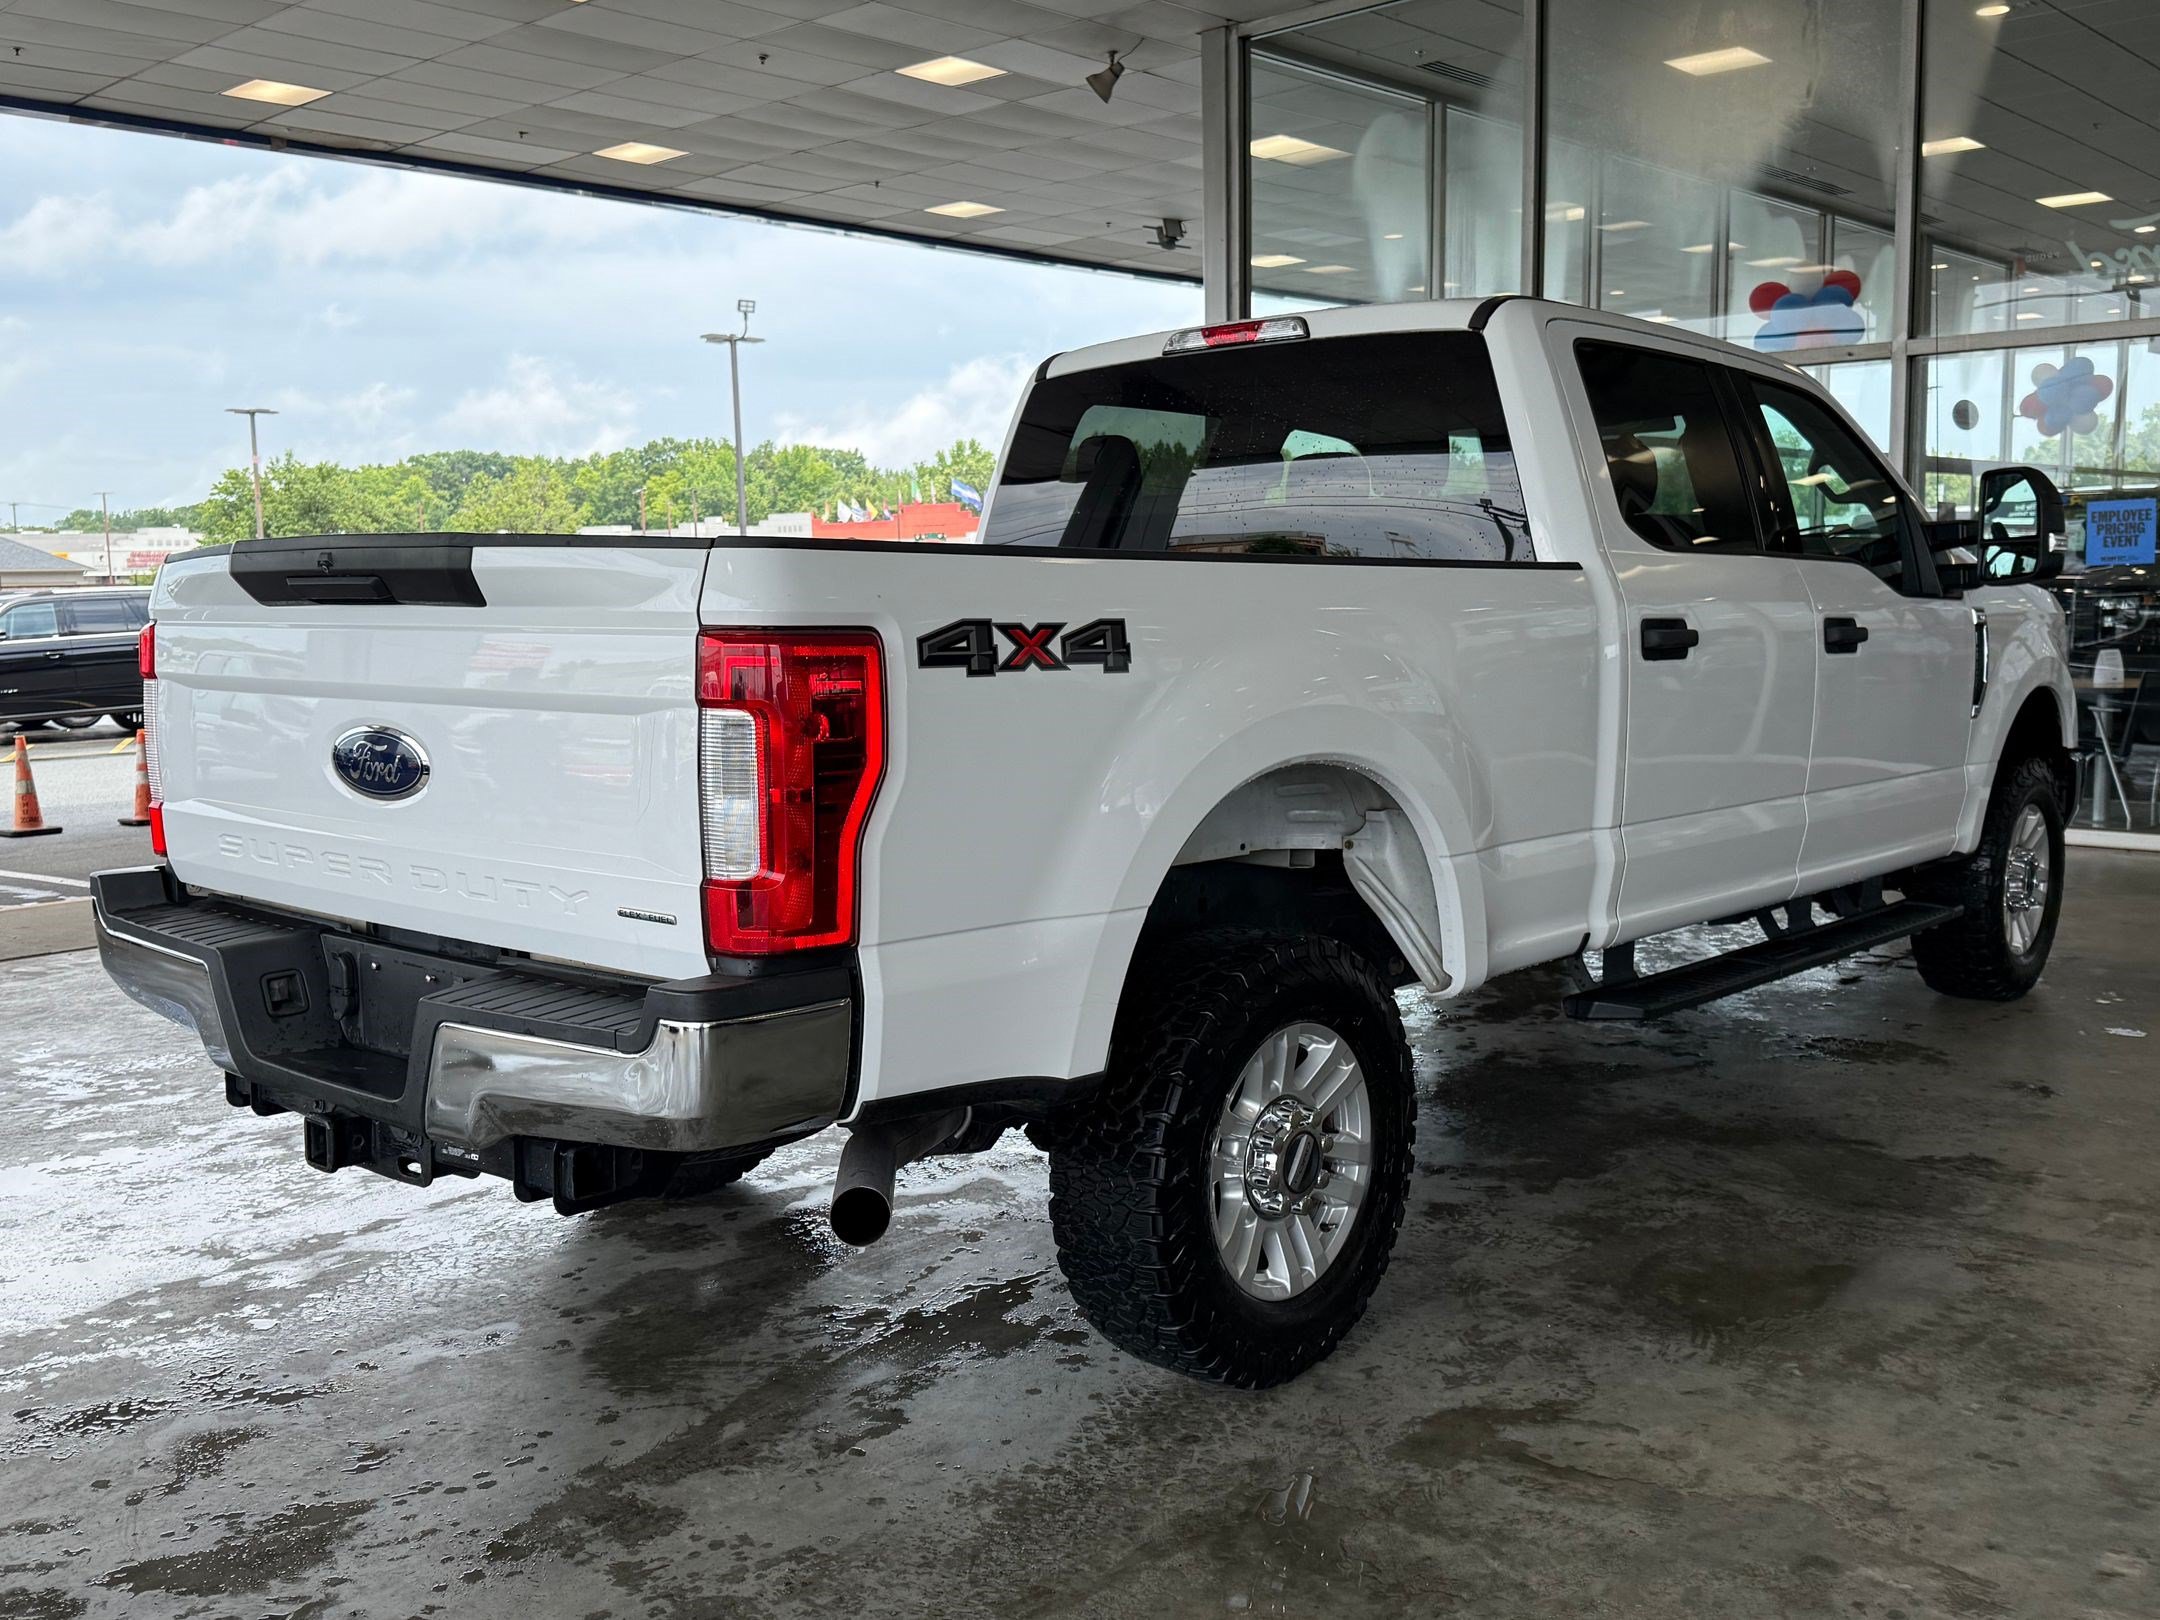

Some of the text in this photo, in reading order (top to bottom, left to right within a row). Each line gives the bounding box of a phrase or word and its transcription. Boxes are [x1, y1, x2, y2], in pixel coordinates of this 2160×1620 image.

[2091, 508, 2153, 523] EMPLOYEE
[2096, 521, 2146, 536] PRICING
[2103, 534, 2140, 548] EVENT
[349, 740, 401, 784] Ford
[218, 833, 590, 916] SUPER DUTY
[617, 909, 675, 925] FLEX FUEL
